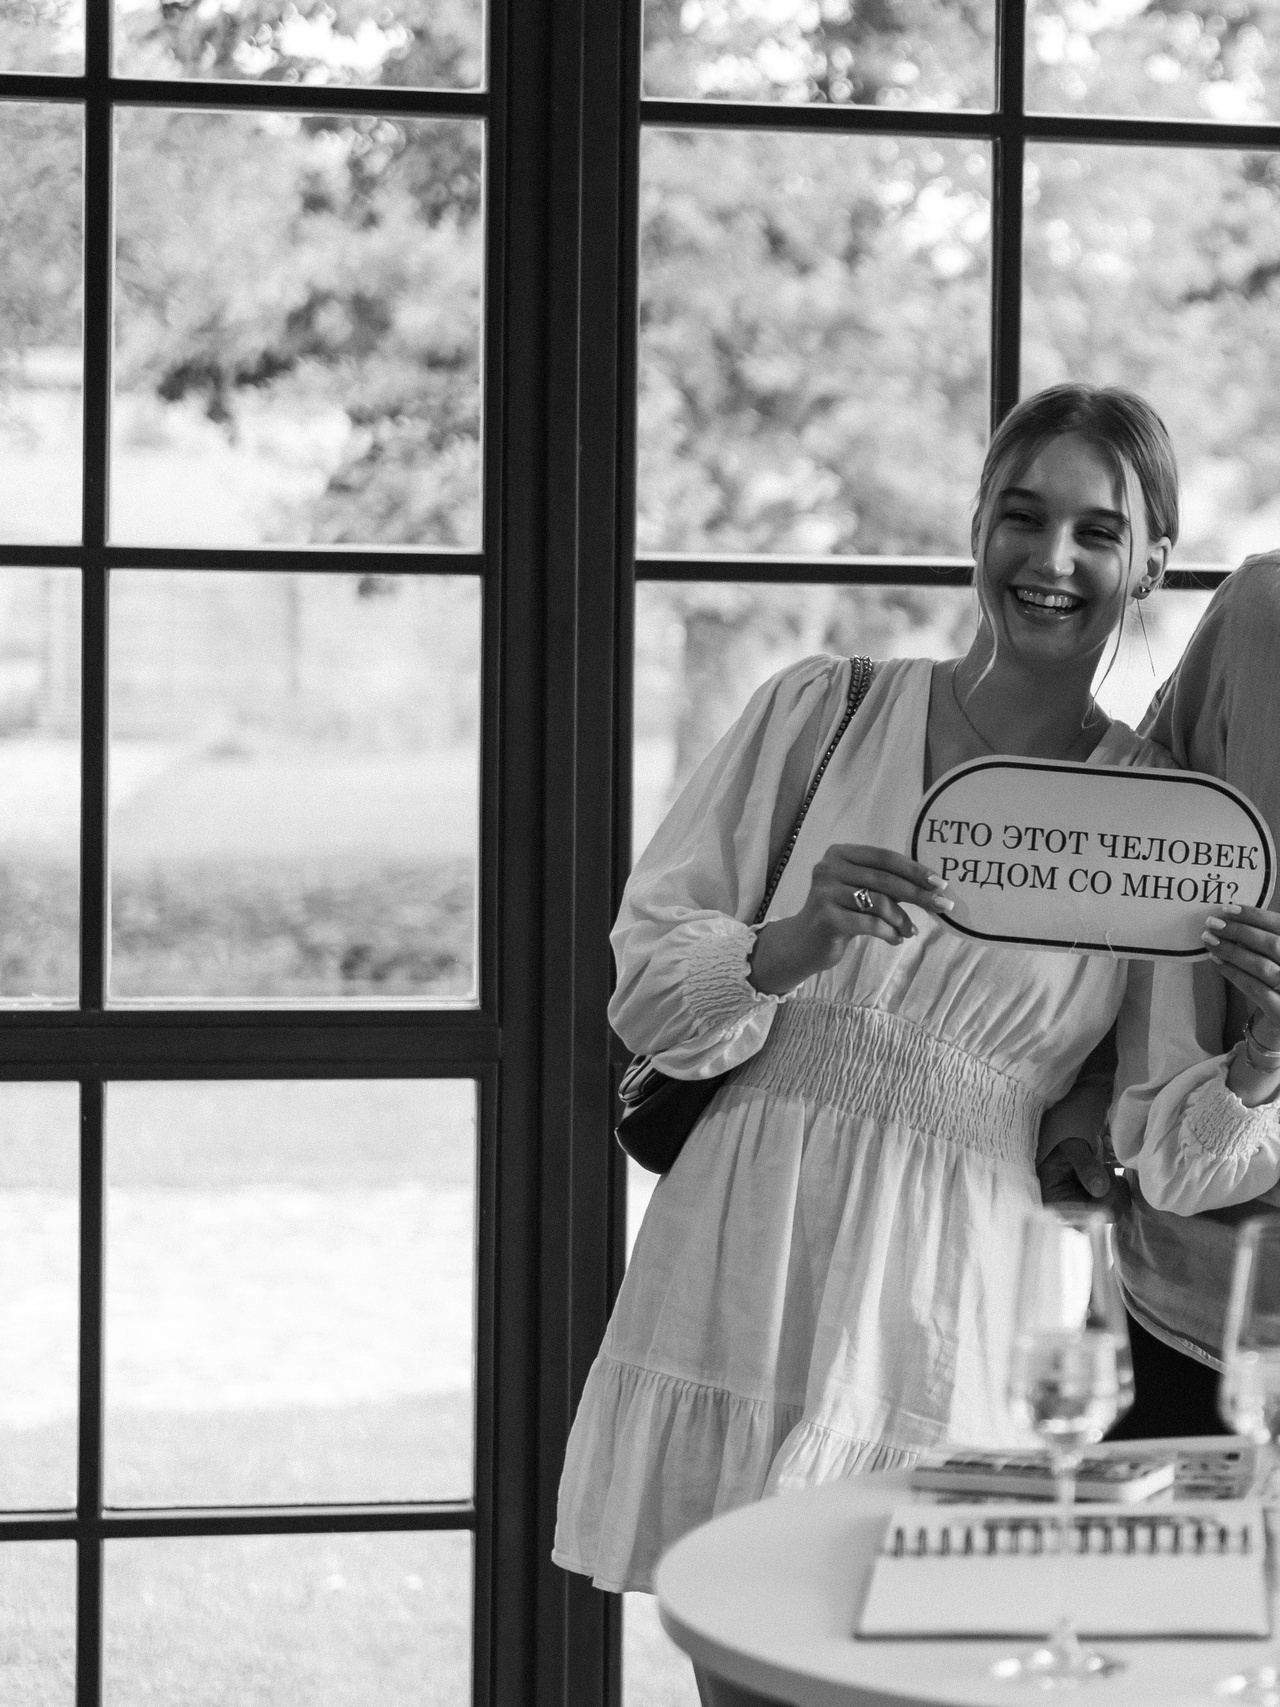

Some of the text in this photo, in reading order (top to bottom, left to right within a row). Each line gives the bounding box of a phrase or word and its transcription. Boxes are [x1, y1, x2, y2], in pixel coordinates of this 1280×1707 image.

[926, 819, 1259, 870] КТО ЭТОТ ЧЕЛОВЕК
[939, 857, 1239, 905] РЯДОМ СО МНОЙ?
